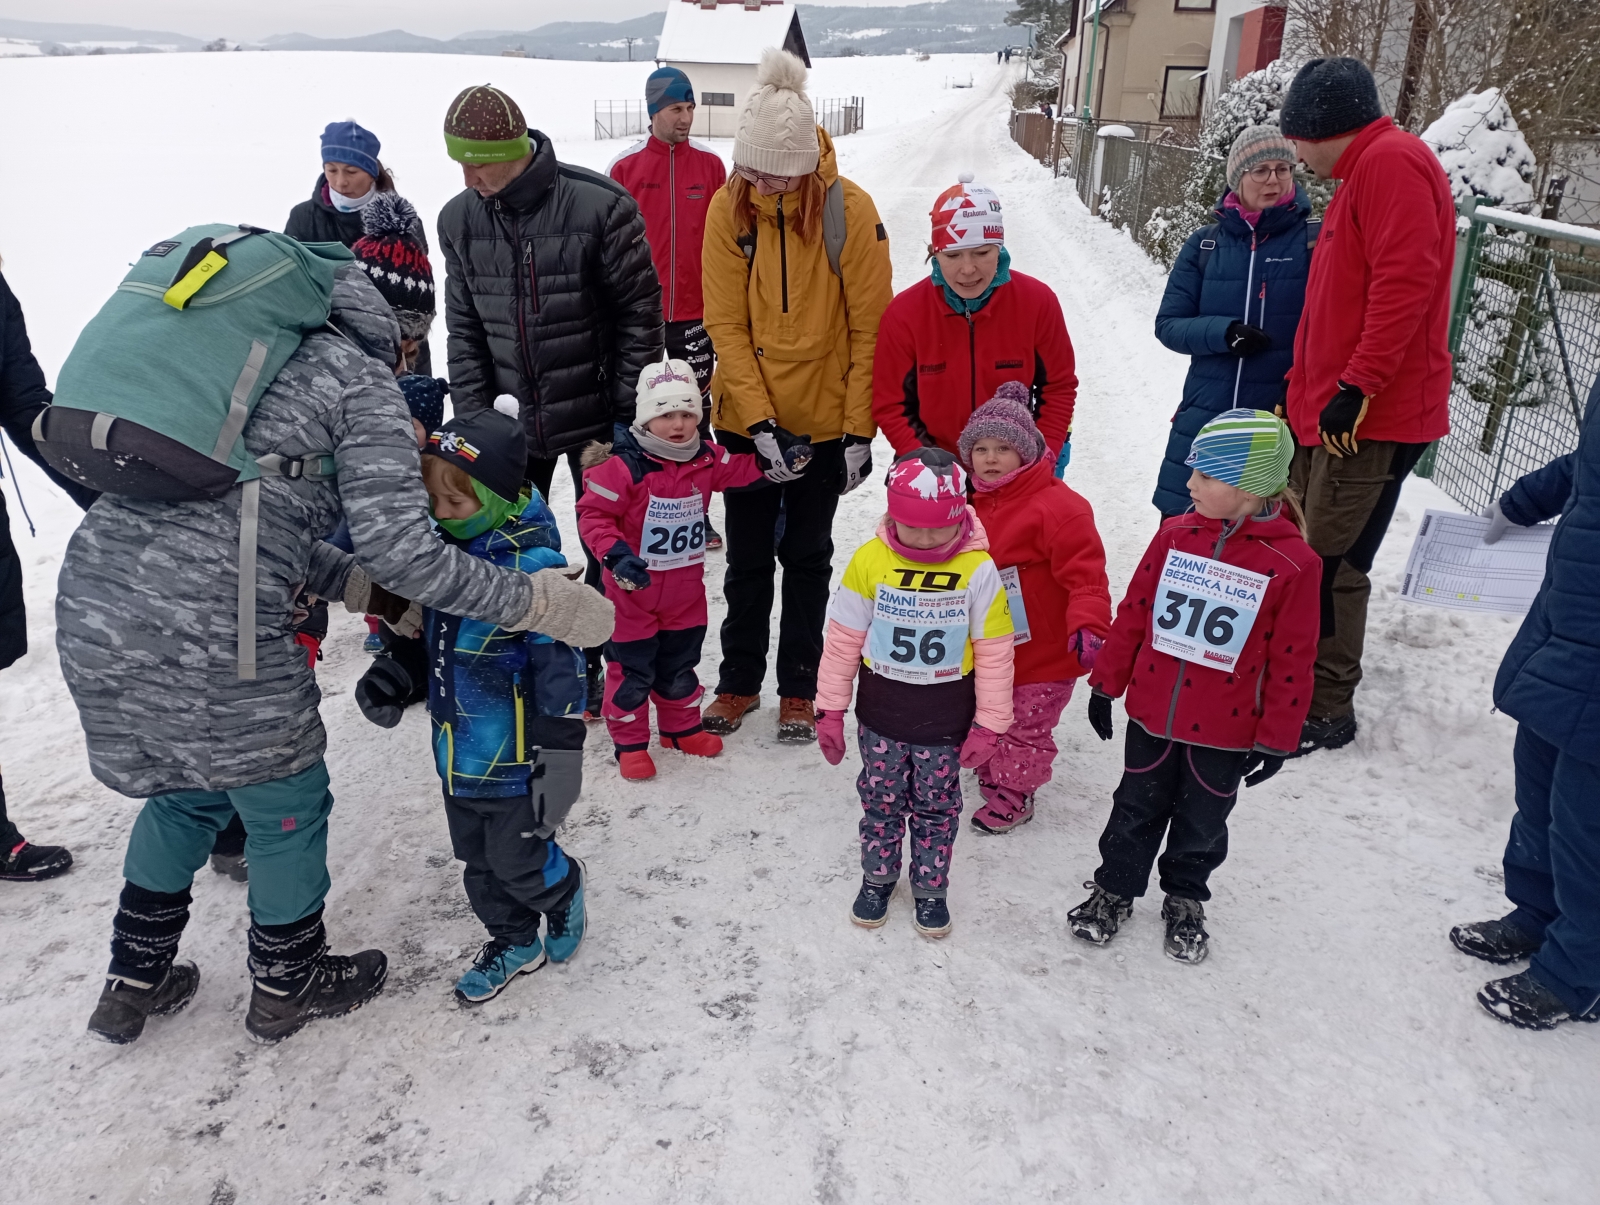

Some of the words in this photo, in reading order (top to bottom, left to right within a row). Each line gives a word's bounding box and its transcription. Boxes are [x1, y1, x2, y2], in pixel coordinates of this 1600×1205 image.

[650, 500, 682, 510] ZIMNÍ
[648, 510, 692, 519] BĚŽECKÁ
[647, 521, 704, 555] 268
[1169, 555, 1208, 574] ZIMNÍ
[1165, 568, 1221, 592] BĚŽECKÁ
[1225, 585, 1257, 602] LIGA
[1207, 569, 1262, 590] 2025-2026
[879, 589, 917, 607] ZIMNÍ
[918, 599, 966, 608] 2025-2026
[877, 602, 935, 619] BĚŽECKÁ
[939, 608, 966, 619] LIGA
[1157, 590, 1239, 646] 316
[889, 626, 946, 666] 56
[1204, 650, 1234, 662] MARATON
